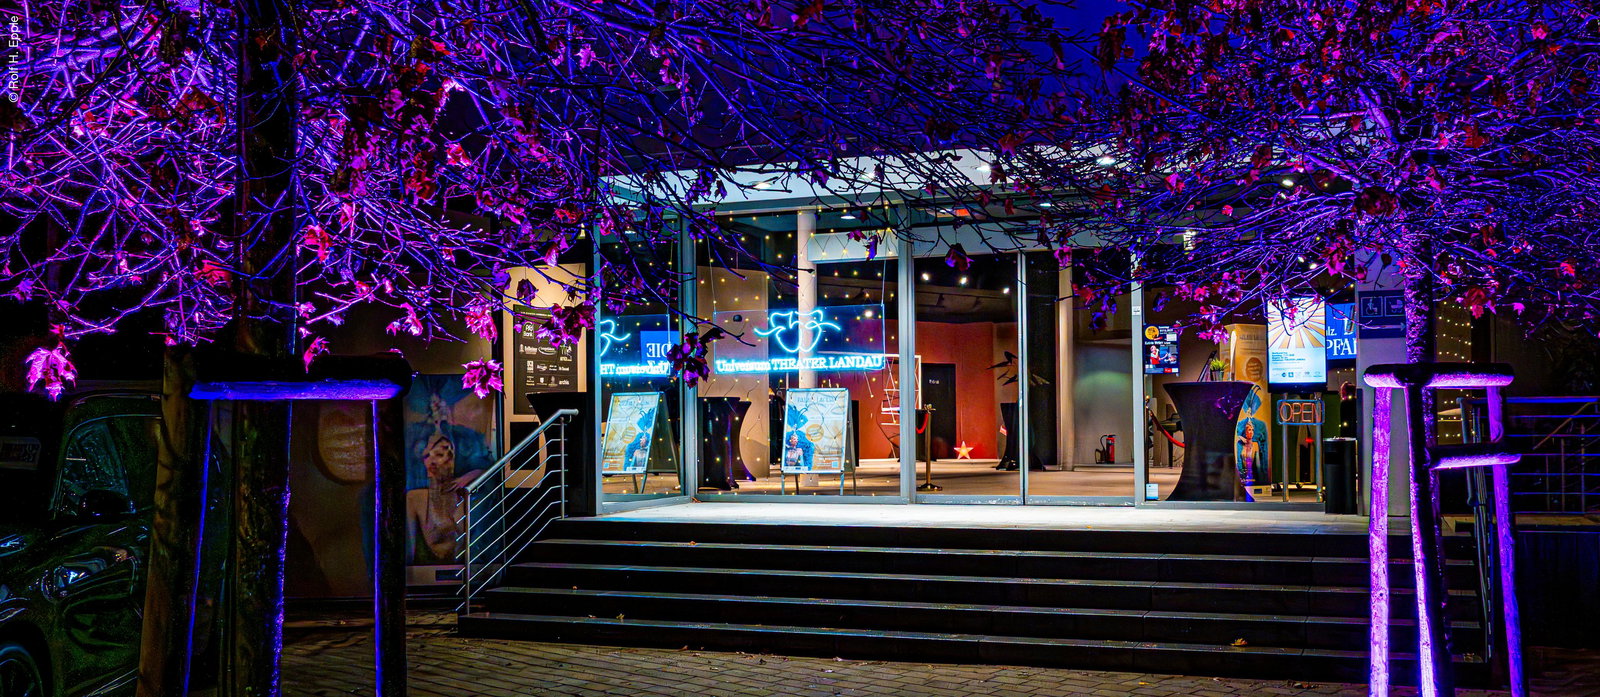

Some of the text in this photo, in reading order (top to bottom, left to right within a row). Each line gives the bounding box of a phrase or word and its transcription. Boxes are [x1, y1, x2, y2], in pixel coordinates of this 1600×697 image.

[716, 355, 883, 372] Universum THEATER LANDAU
[1280, 402, 1321, 422] OPEN
